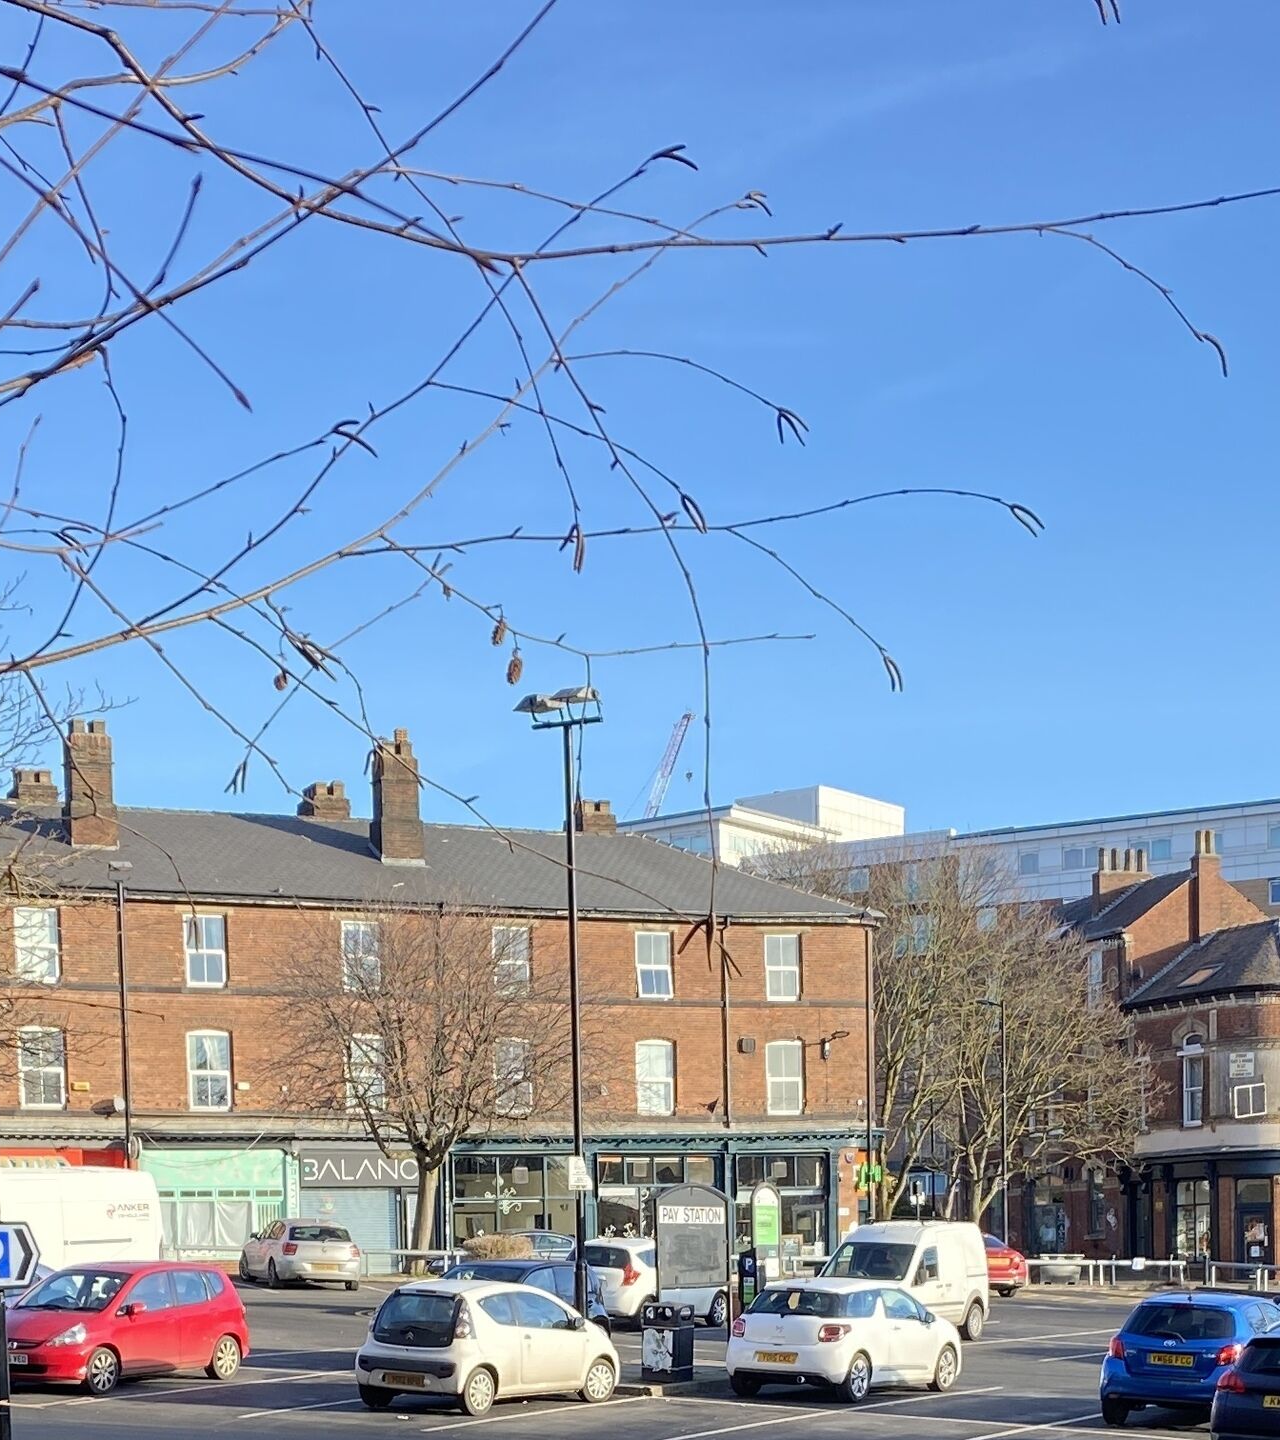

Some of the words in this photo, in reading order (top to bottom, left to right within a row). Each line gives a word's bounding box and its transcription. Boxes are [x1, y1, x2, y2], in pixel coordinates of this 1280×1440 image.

[303, 1158, 419, 1181] BALANC
[117, 1203, 150, 1211] ANKER
[662, 1207, 680, 1223] PAY
[683, 1207, 722, 1223] STATION
[744, 1257, 753, 1271] P
